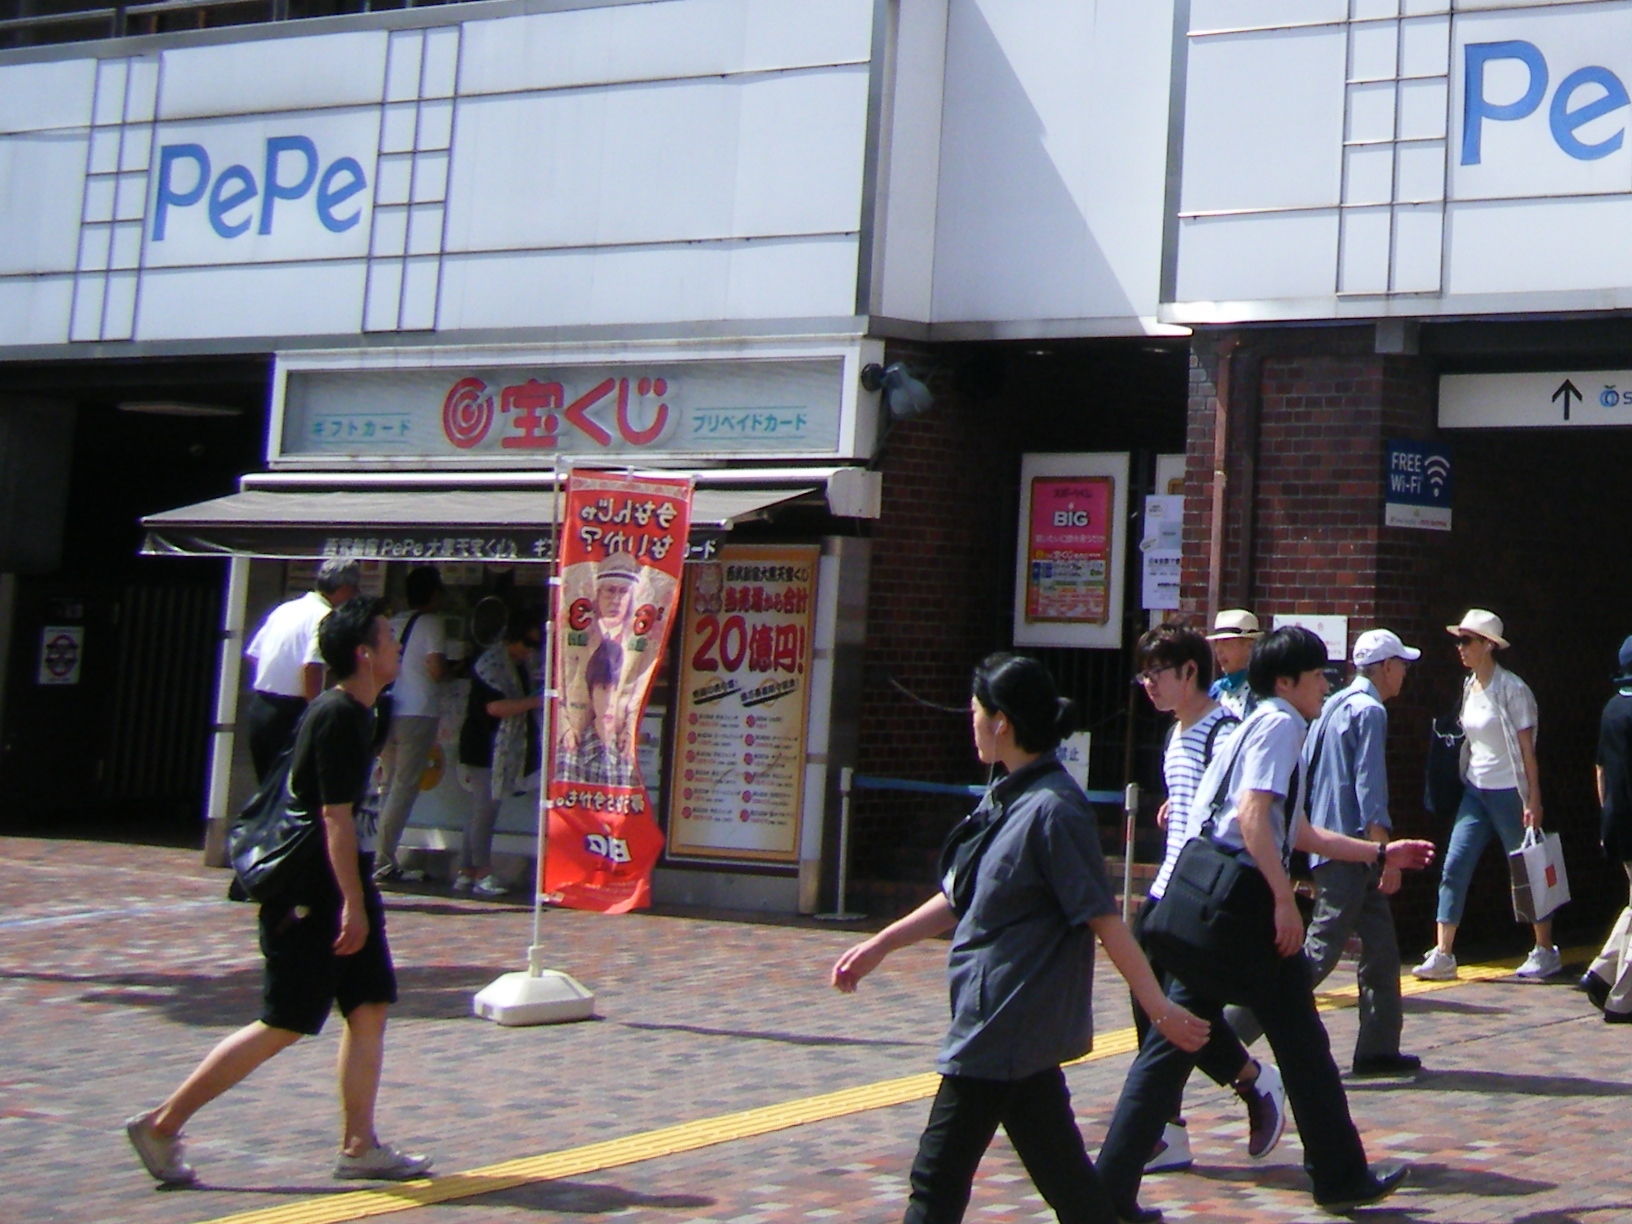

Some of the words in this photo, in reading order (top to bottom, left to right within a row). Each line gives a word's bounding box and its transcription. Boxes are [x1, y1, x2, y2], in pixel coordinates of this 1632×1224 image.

[152, 135, 367, 242] PePe
[502, 376, 669, 448] 宝くじ
[312, 417, 410, 438] ギフトカード
[1391, 452, 1422, 473] FREE
[1391, 474, 1421, 494] Wi-Fi
[1053, 508, 1089, 526] BIG
[692, 614, 805, 674] 20億円!
